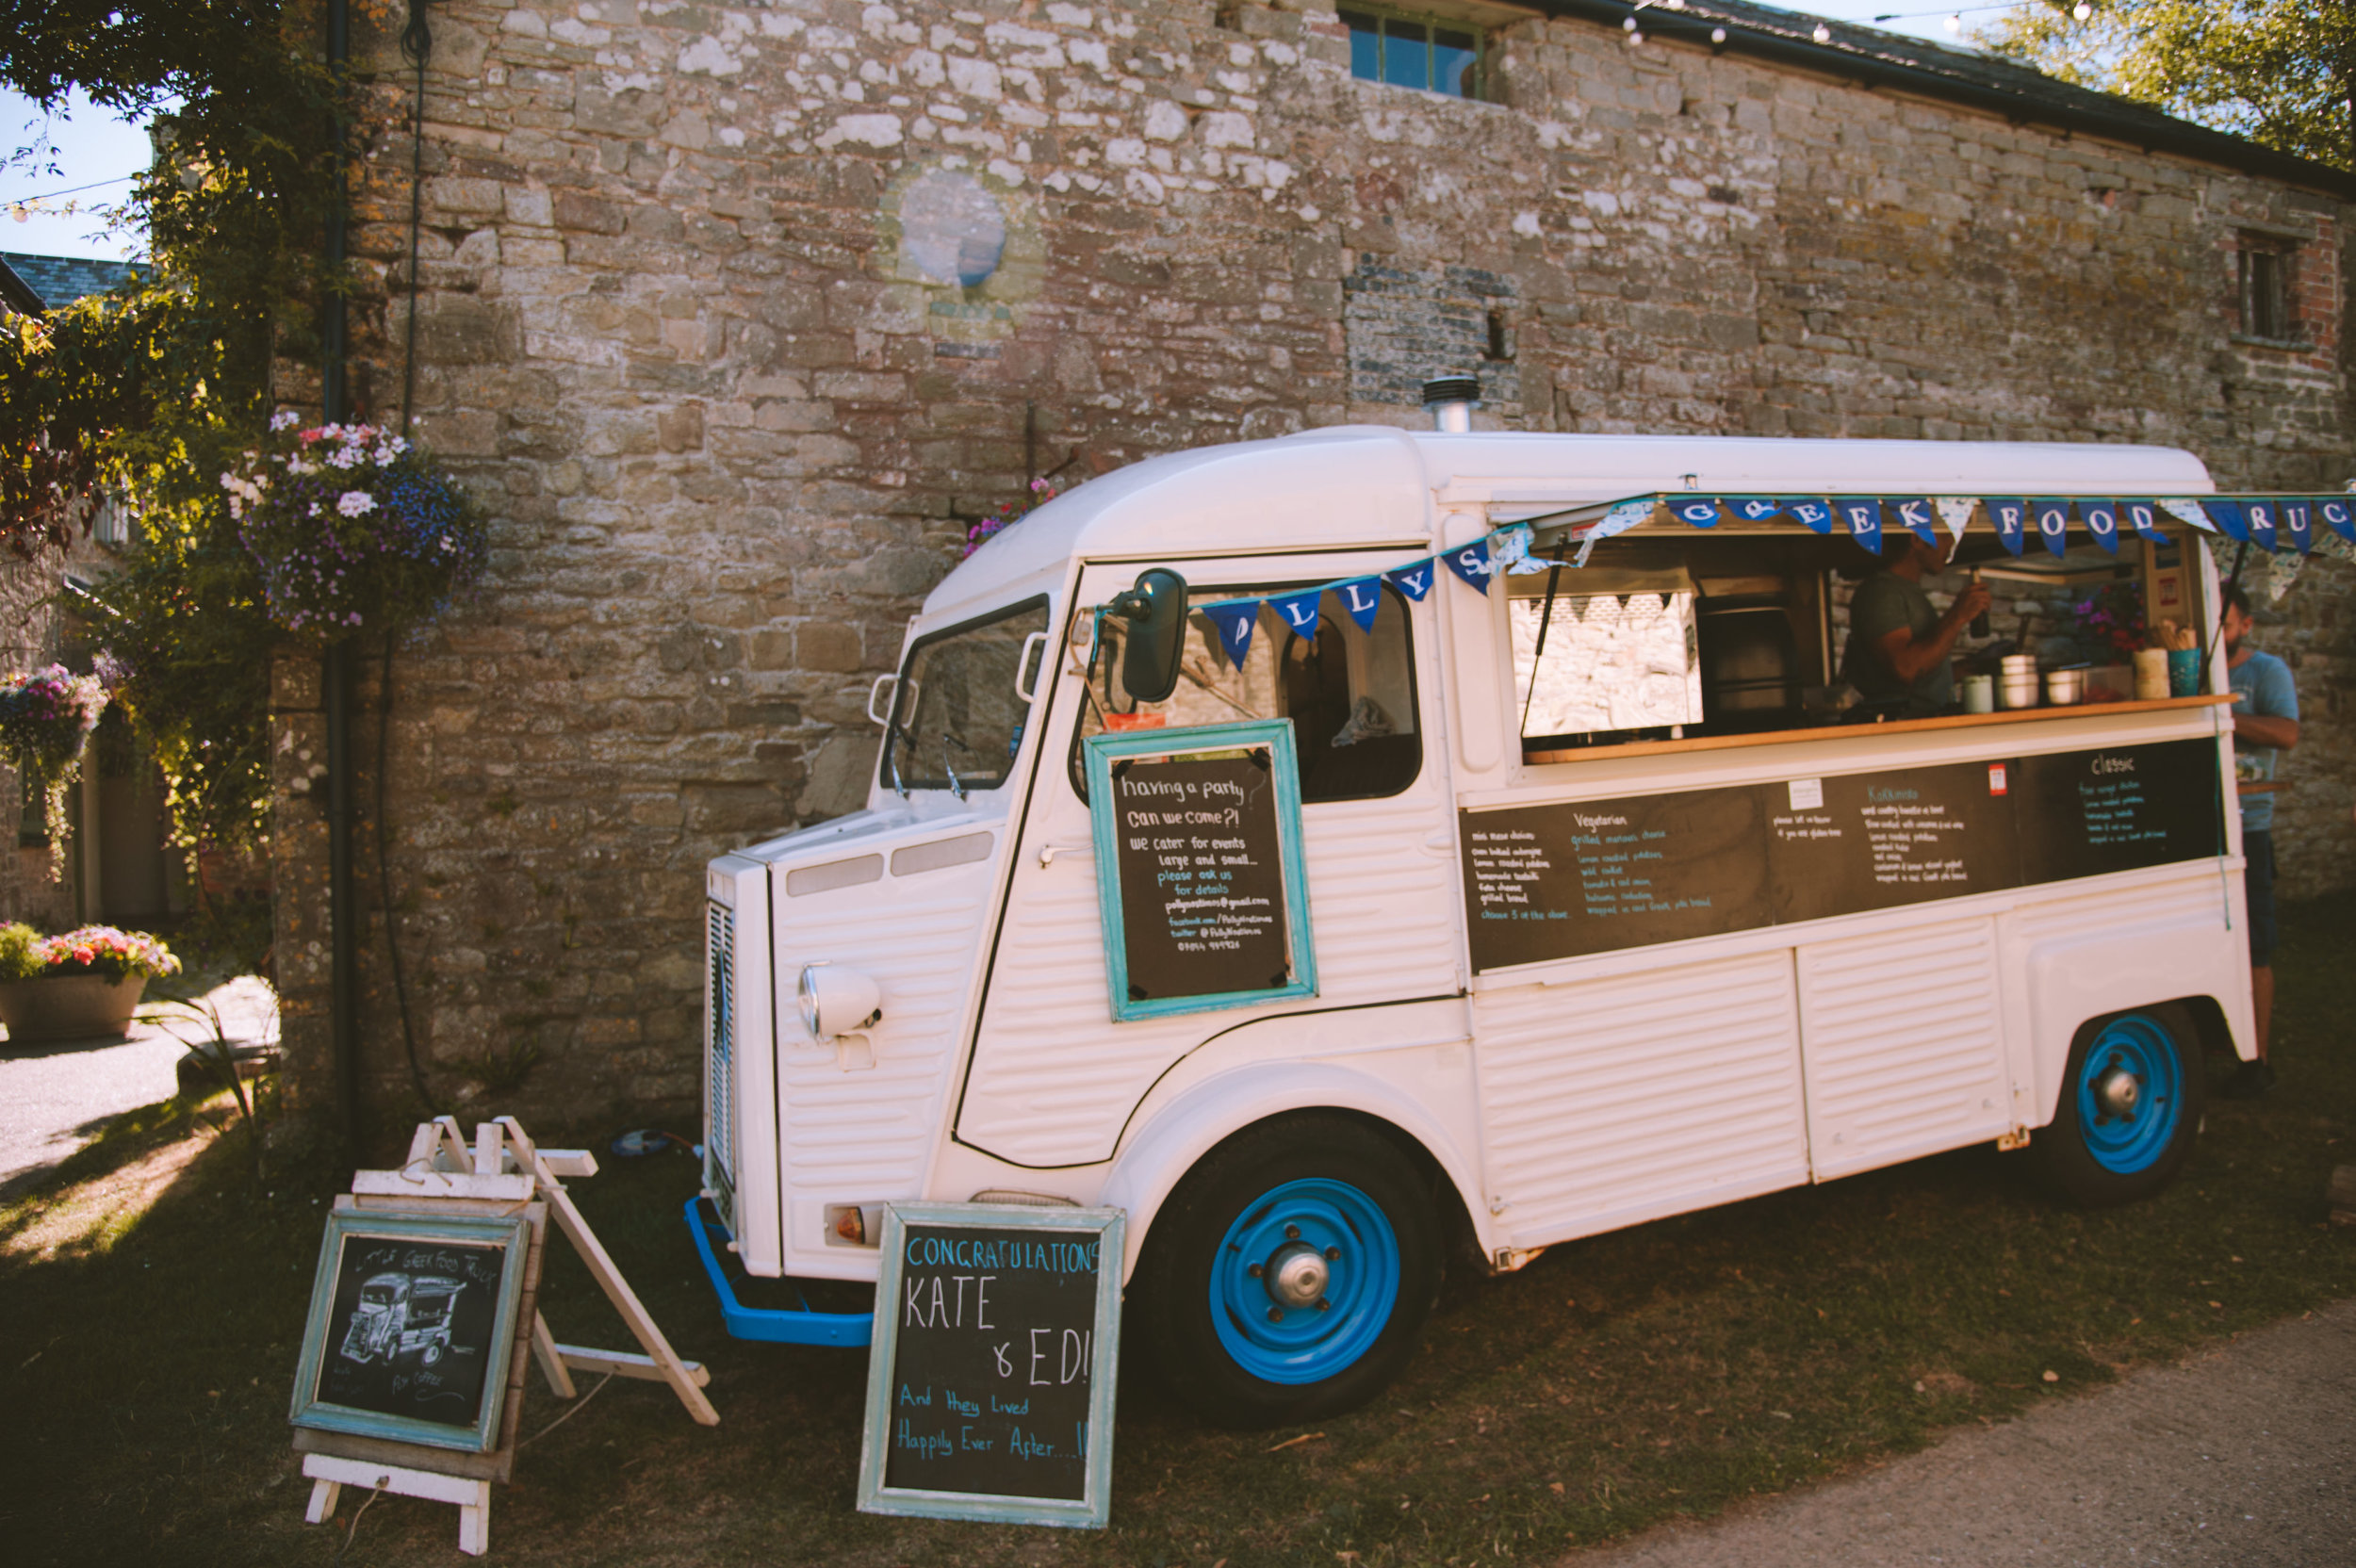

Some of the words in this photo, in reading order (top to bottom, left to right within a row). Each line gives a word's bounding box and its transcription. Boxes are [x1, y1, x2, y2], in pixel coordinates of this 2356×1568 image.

[2000, 505, 2153, 535] FOOD
[1121, 776, 1186, 803] having
[1186, 782, 1198, 793] a
[1162, 812, 1183, 825] we
[1573, 812, 1628, 834] Vegetarian
[1153, 837, 1185, 851] cater
[1190, 836, 1209, 849] for
[1211, 837, 1246, 850] events
[1195, 853, 1216, 866] and
[1157, 869, 1192, 888] please
[1198, 869, 1218, 880] ask
[1219, 871, 1233, 881] us
[1174, 884, 1192, 895] for
[1195, 883, 1230, 895] details
[907, 1236, 1100, 1273] CONGRATULATIONS
[906, 1276, 996, 1329] KATE
[1029, 1329, 1089, 1385] ED!
[900, 1383, 931, 1408] And
[945, 1389, 980, 1417] they
[898, 1417, 954, 1461] Happily
[961, 1425, 994, 1451] Ever
